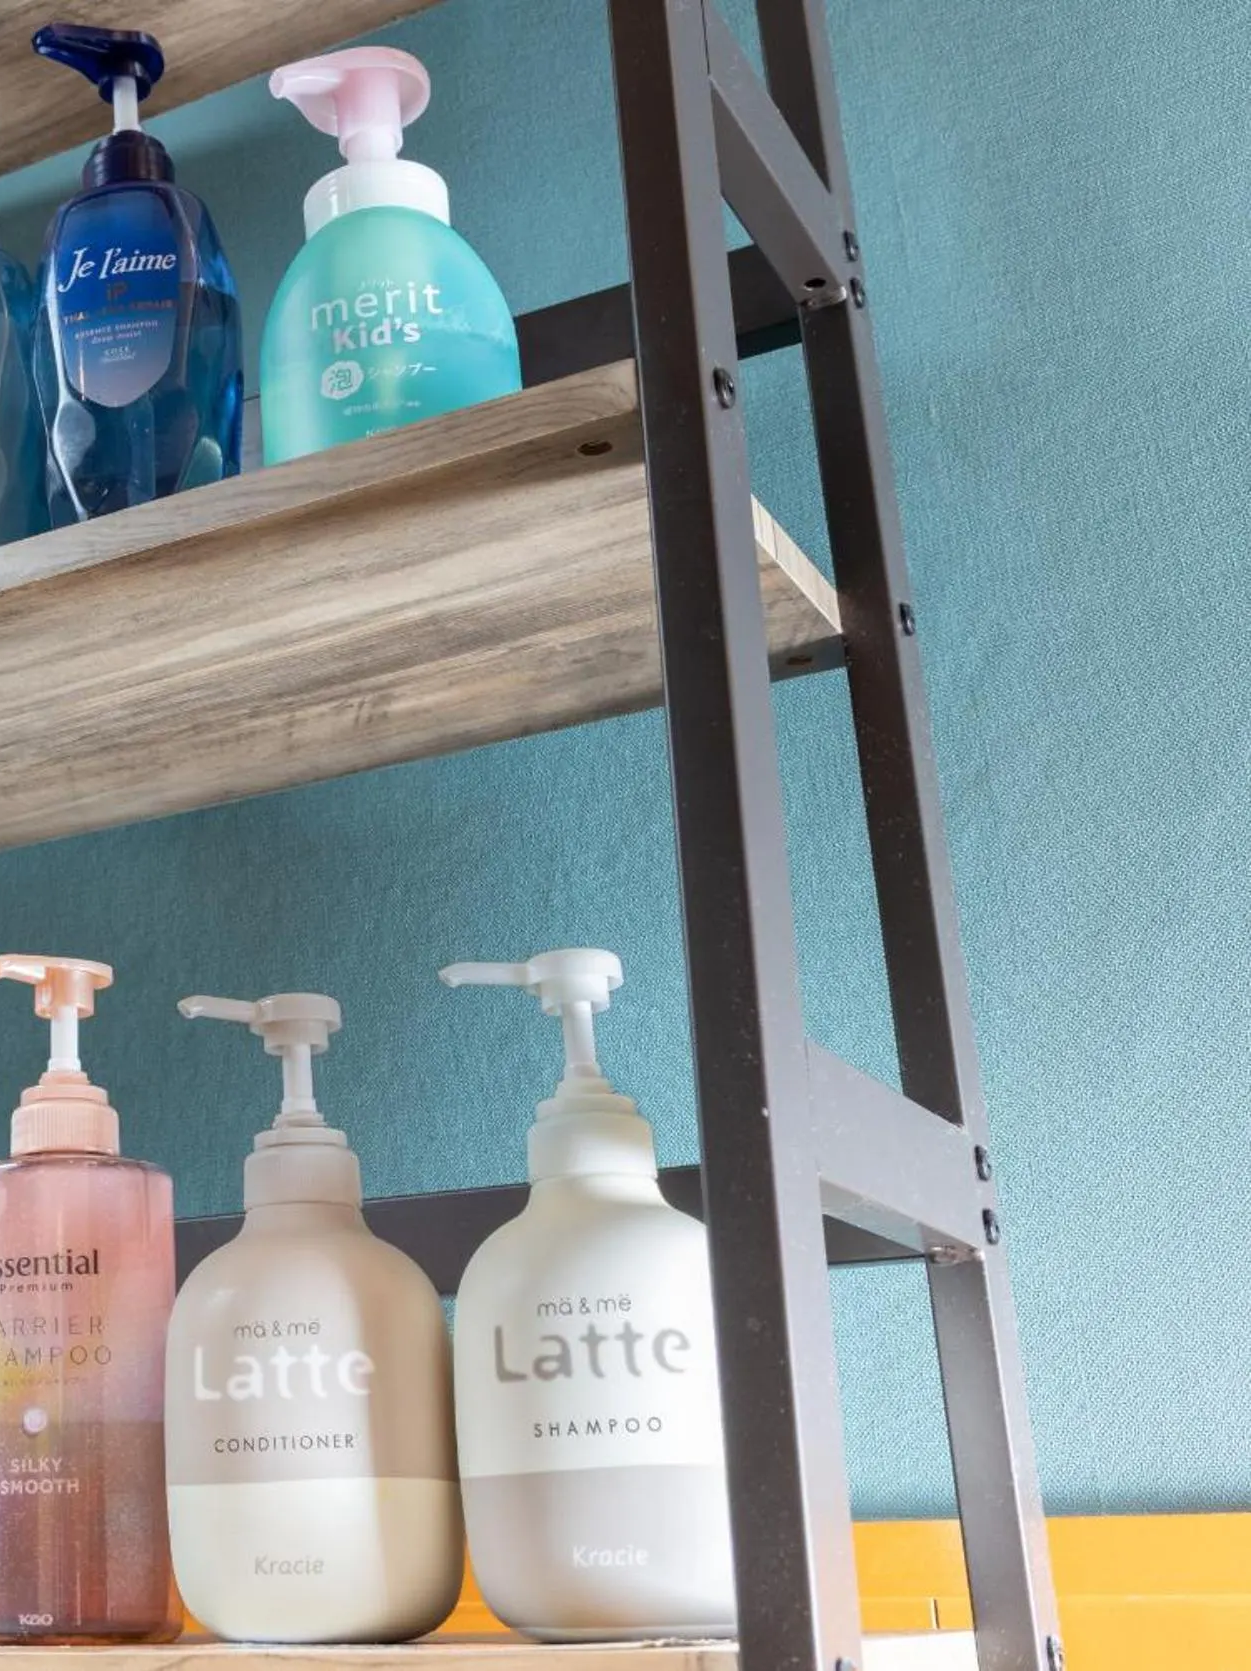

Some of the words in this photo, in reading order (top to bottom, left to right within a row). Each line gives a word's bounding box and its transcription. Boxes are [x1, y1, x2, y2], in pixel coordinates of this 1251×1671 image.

[58, 247, 95, 293] Je
[99, 248, 177, 280] l'aime
[311, 281, 443, 330] merit
[333, 316, 421, 354] Kid's
[0, 1281, 73, 1294] Premium
[579, 1297, 591, 1315] &
[272, 1320, 284, 1338] &
[494, 1321, 691, 1383] Latte
[194, 1343, 375, 1400] Latte
[534, 1416, 662, 1438] SHAMPOO
[214, 1433, 355, 1454] CONDITIONER
[10, 1457, 63, 1473] SILKY
[254, 1555, 325, 1575] Kracie
[572, 1545, 649, 1567] Kracie
